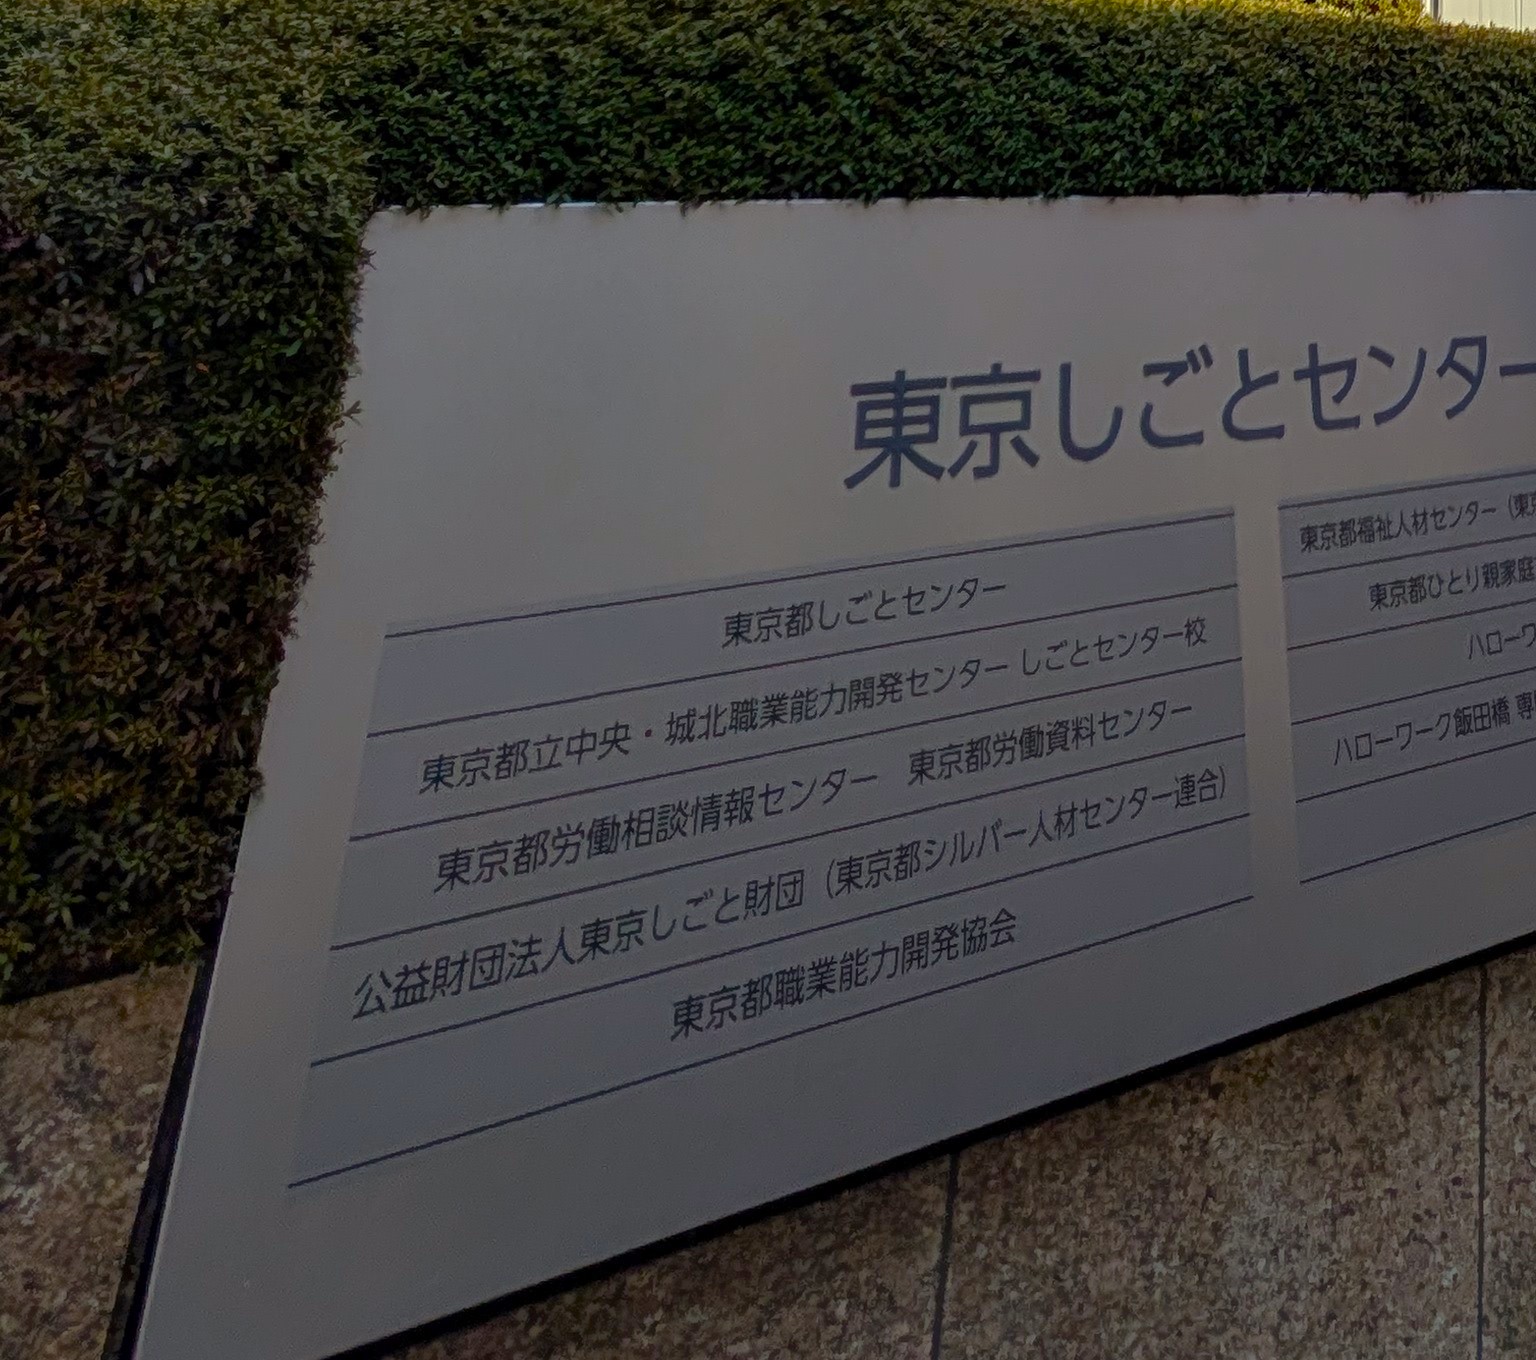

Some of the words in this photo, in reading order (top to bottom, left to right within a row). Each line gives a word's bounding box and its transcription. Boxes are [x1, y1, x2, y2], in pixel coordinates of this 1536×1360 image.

[721, 578, 1007, 649] 東京都しごとセンター
[418, 658, 1009, 795] 東京都立中央・城北職業能力開発センター
[1021, 616, 1208, 676] しごとセンター校
[1333, 694, 1512, 767] ハローワーク飯田橋
[433, 767, 878, 895] 東京都労働相談情報センター
[907, 699, 1193, 787] 東京都労働資料センター
[669, 908, 1018, 1042] 東京都職業能力開発協会
